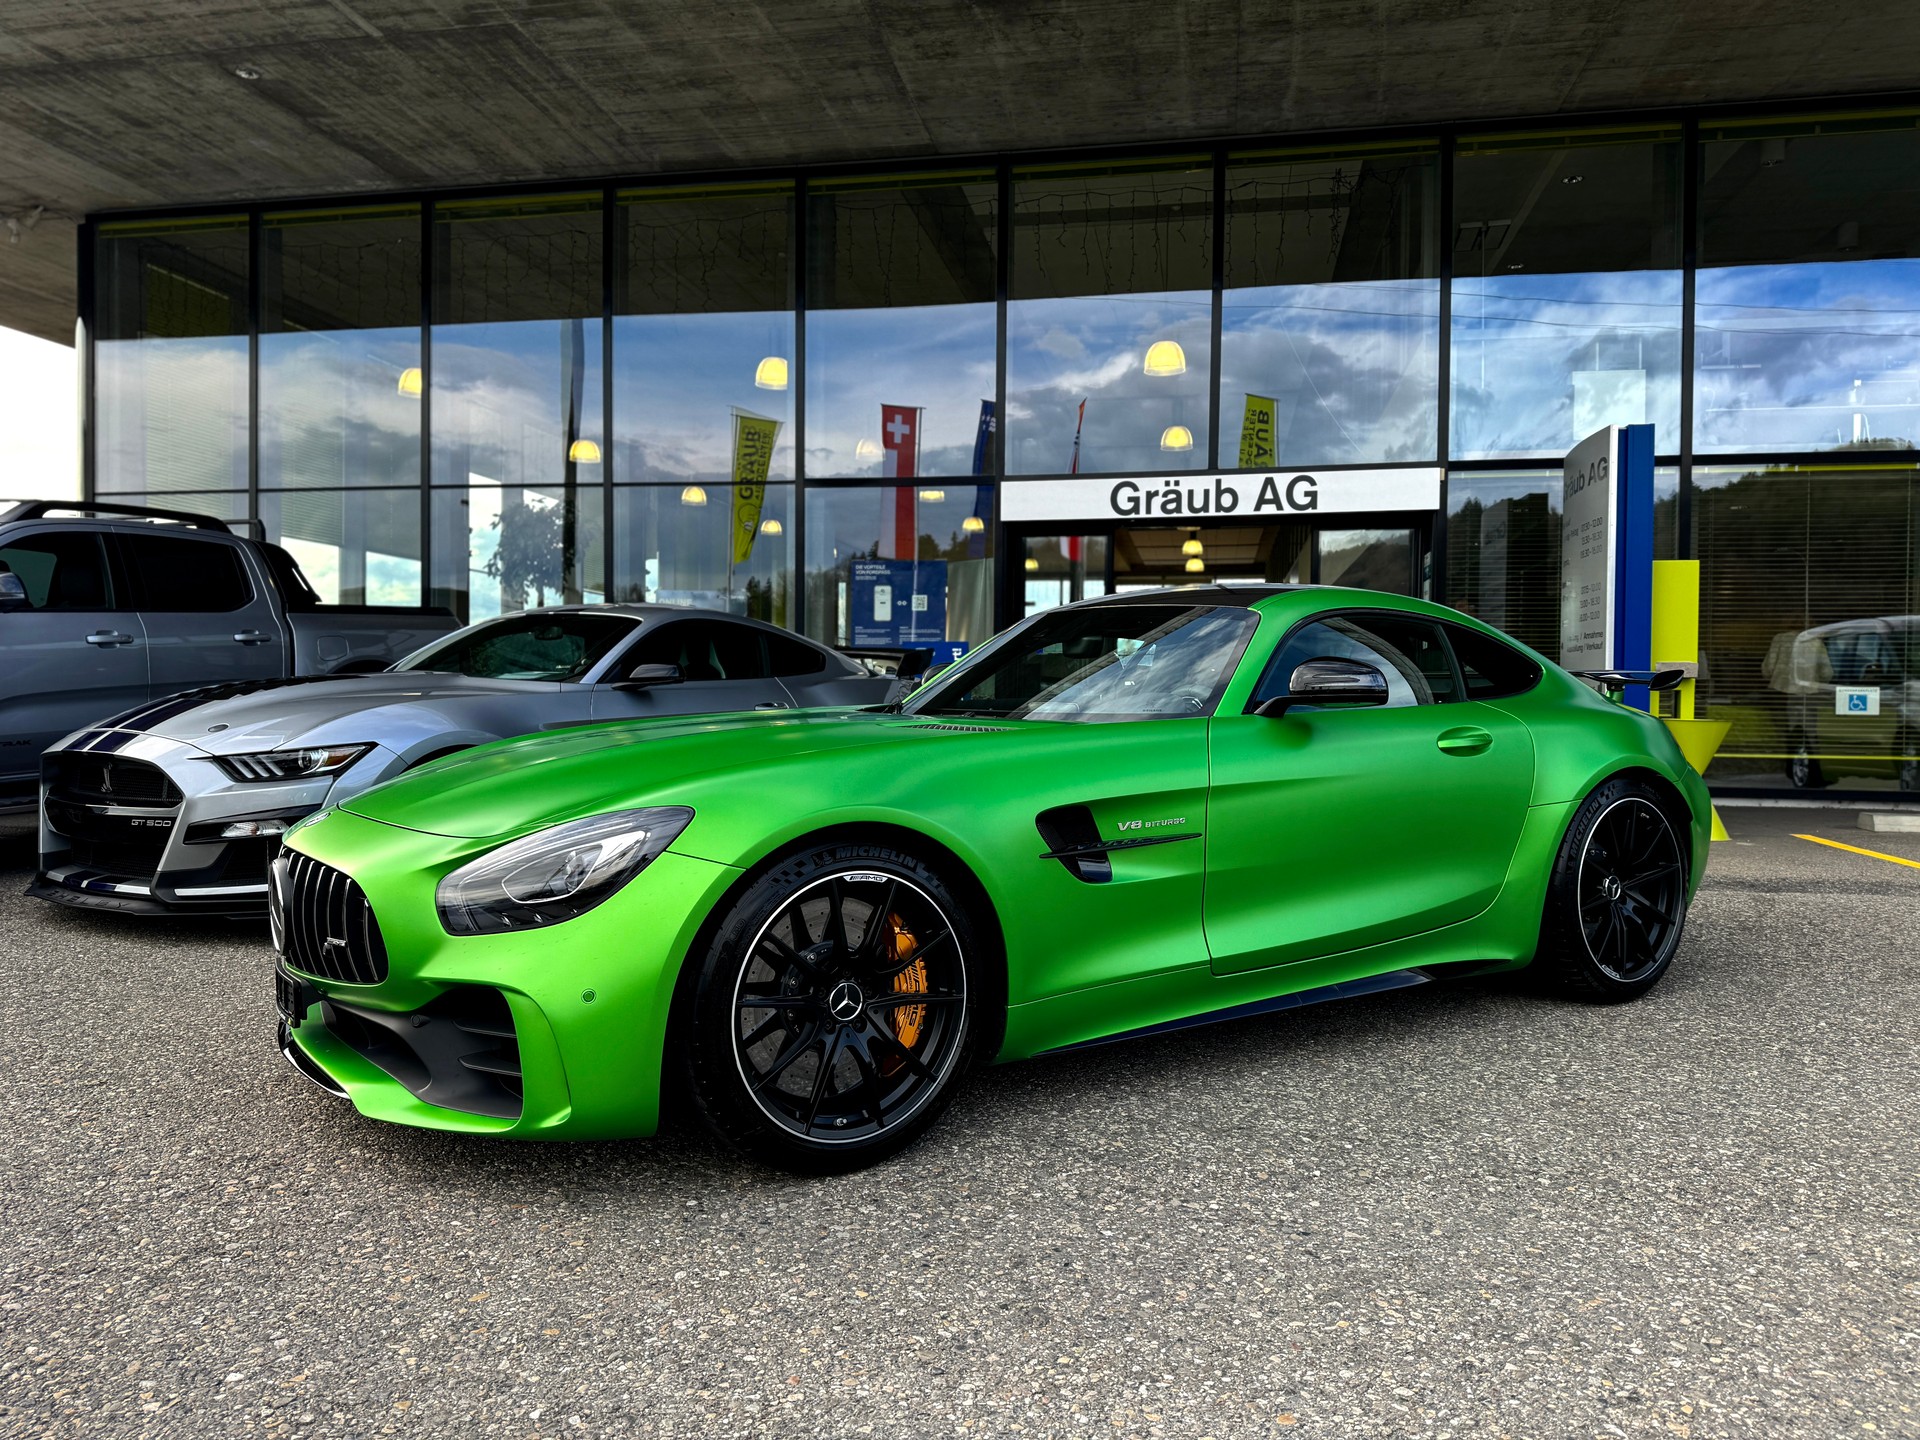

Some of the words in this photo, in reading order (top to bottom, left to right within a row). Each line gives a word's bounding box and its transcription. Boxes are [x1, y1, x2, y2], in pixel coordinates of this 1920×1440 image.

[1110, 478, 1239, 516] Gräub
[1253, 474, 1318, 512] AG
[1563, 469, 1585, 501] räub
[1587, 456, 1608, 487] AG
[1117, 820, 1143, 831] V8
[1145, 817, 1186, 828] BITURBO
[1569, 798, 1602, 858] MICHELIN
[835, 845, 918, 869] MICHELIN
